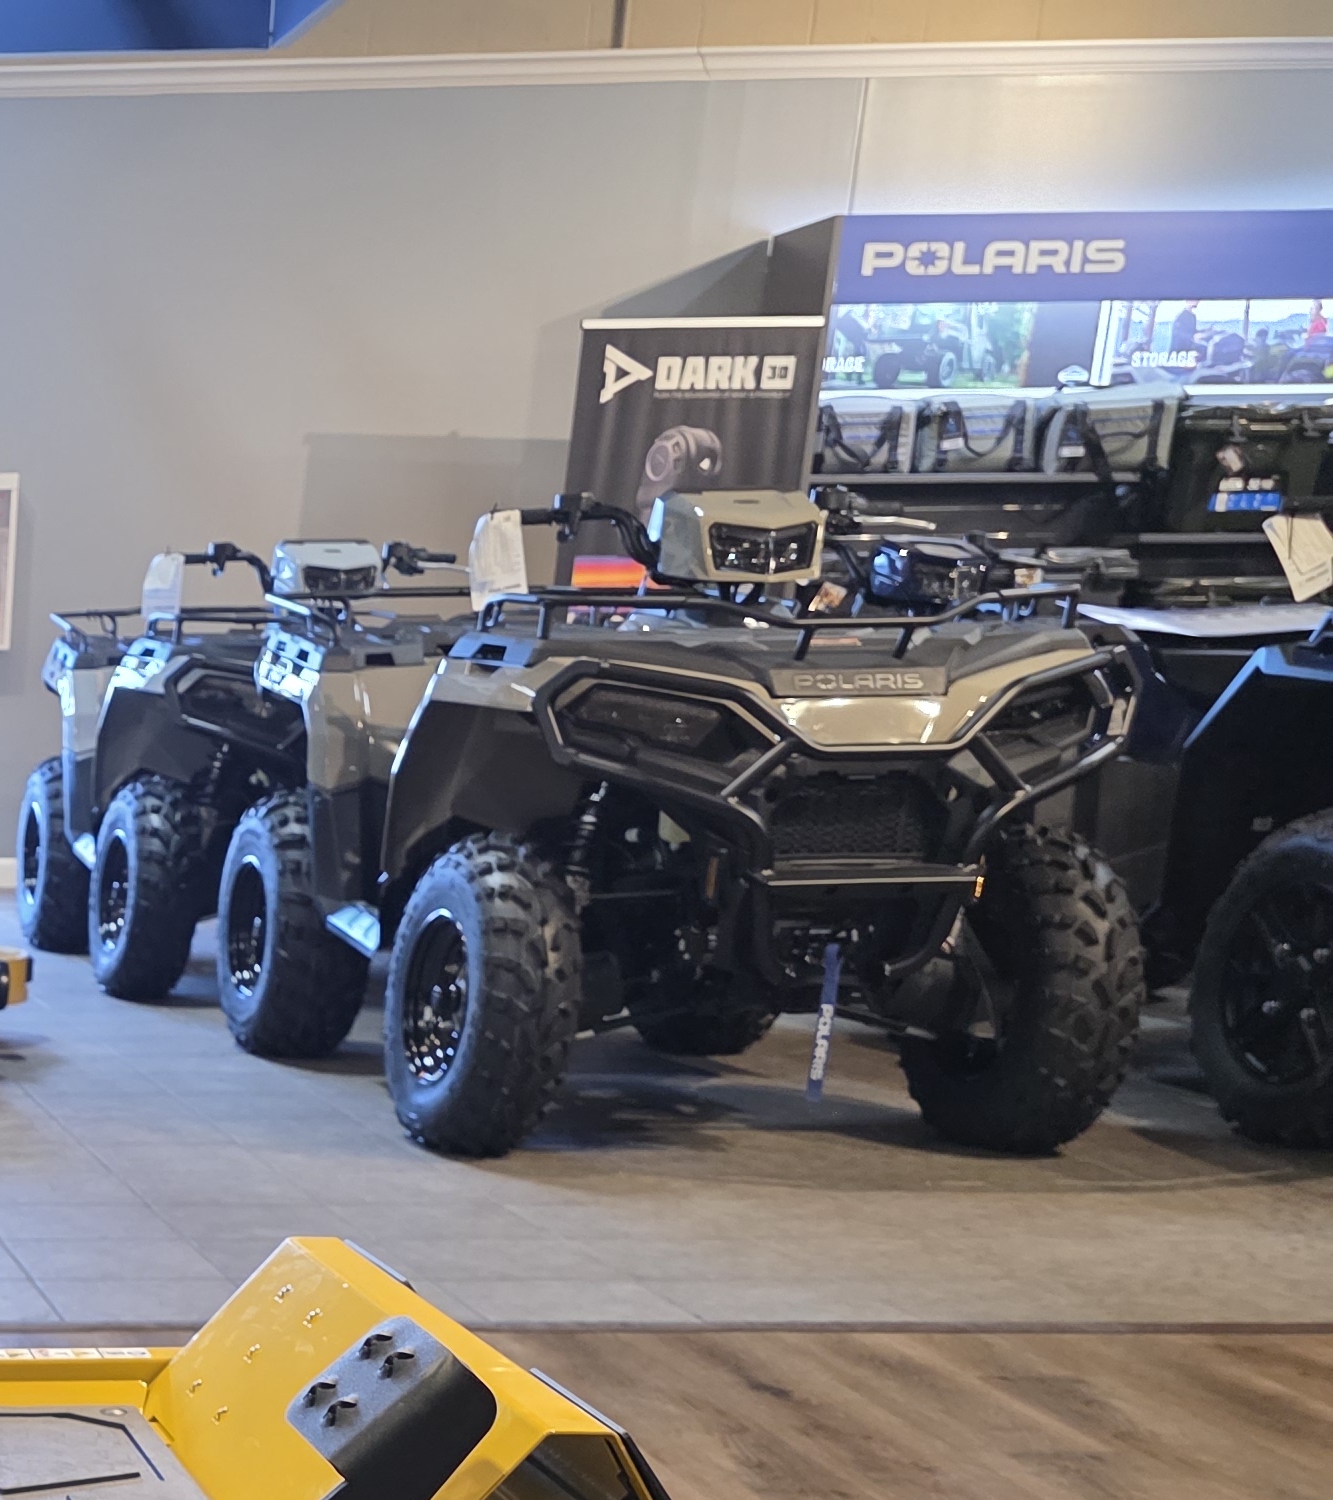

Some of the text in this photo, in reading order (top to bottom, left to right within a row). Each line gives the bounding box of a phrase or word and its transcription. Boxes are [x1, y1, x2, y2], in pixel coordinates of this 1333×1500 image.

[861, 239, 1125, 276] POLARIS
[654, 355, 759, 390] DARK
[794, 673, 924, 690] POLARIS
[810, 1003, 834, 1081] POLARIS
